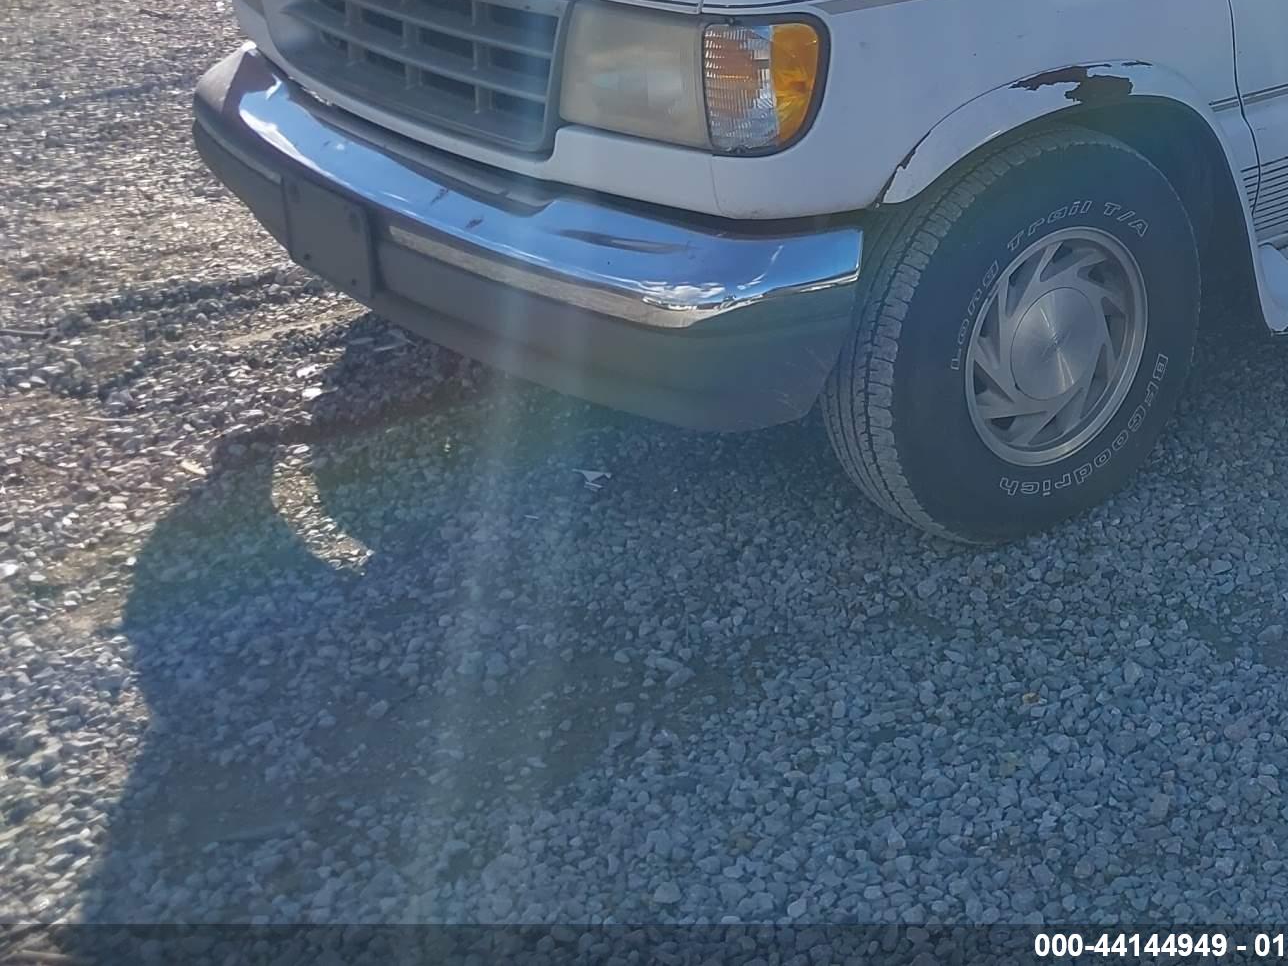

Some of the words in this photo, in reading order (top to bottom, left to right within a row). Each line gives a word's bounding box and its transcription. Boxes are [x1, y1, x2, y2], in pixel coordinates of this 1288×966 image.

[951, 260, 999, 371] Long
[1007, 200, 1092, 251] Trail
[1104, 202, 1149, 237] T/A
[1000, 353, 1168, 496] BFGoodrich
